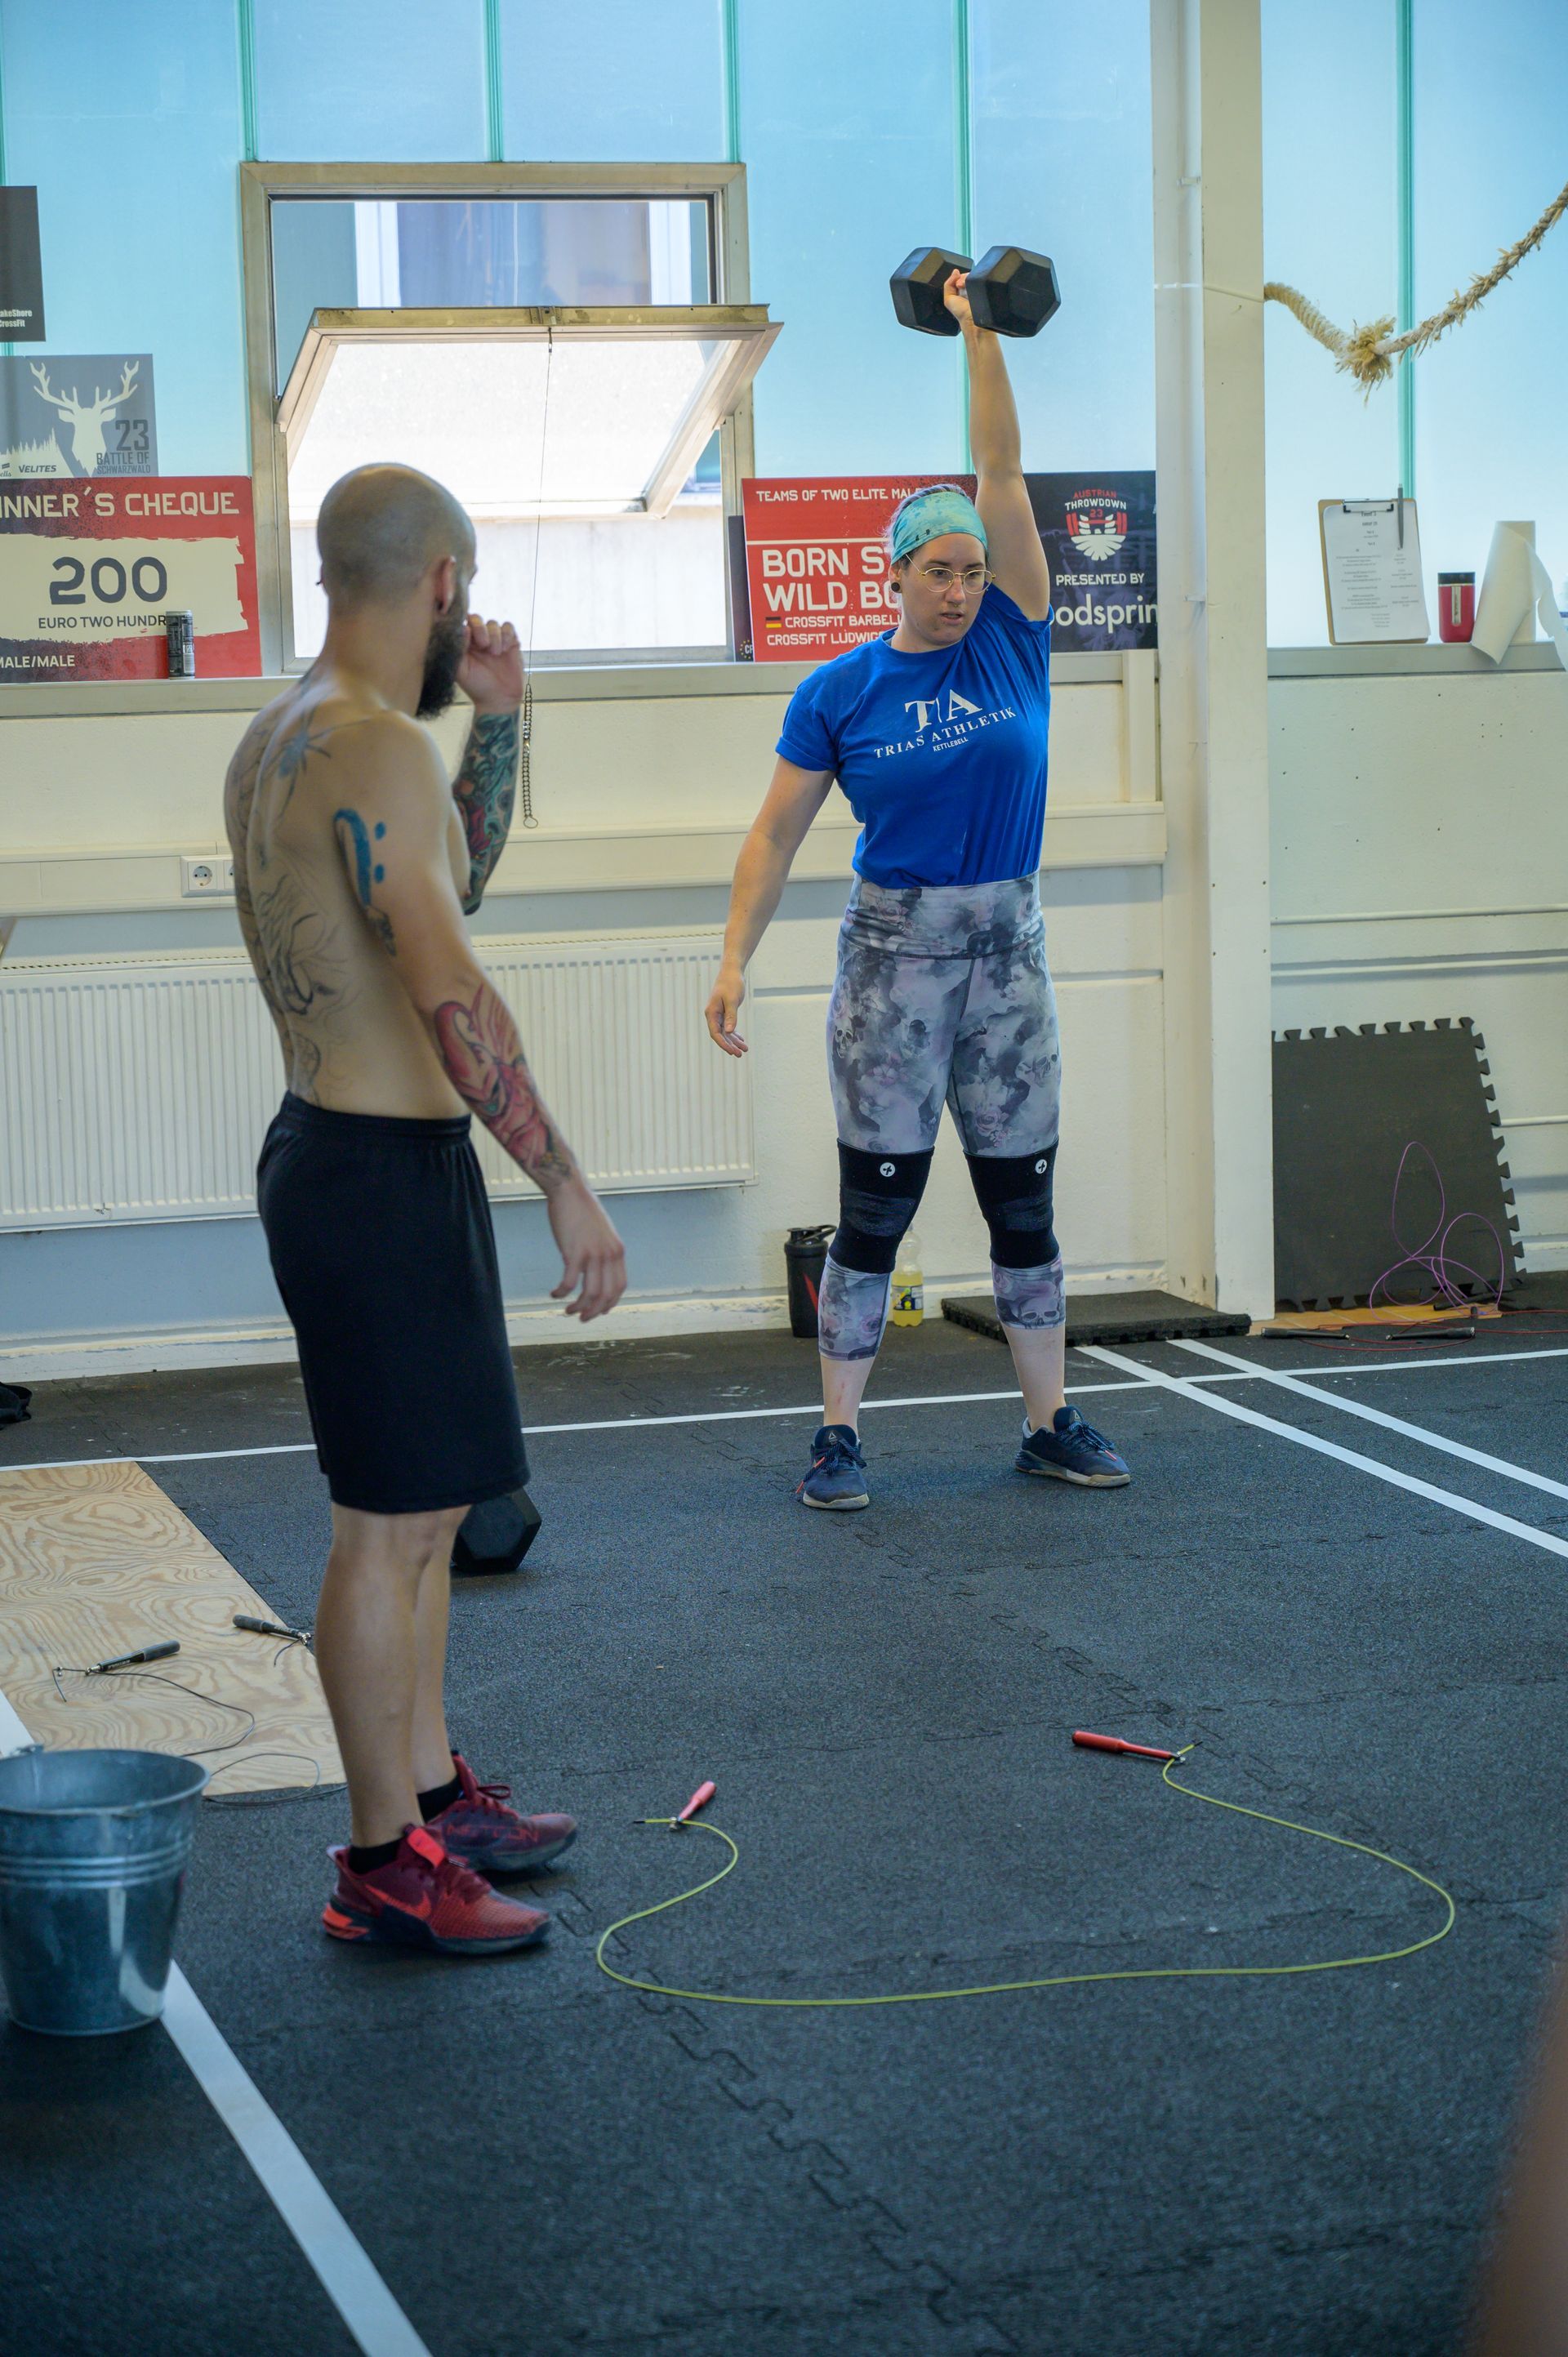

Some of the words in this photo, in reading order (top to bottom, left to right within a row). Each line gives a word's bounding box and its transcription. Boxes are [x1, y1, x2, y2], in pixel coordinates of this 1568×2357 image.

[115, 419, 150, 452] 23
[96, 452, 133, 466] BATTLE
[136, 451, 150, 465] OF
[18, 465, 57, 474] VELITES
[96, 464, 151, 475] SCHWARZWALD
[756, 490, 799, 502] TEAMS
[801, 490, 818, 501] OF
[821, 489, 849, 501] TWO
[852, 488, 889, 500] ELITE
[891, 488, 921, 499] MAL
[1072, 489, 1117, 499] AUSTRIAN
[125, 492, 240, 517] CHEQUE
[1064, 497, 1127, 511] THROWDOWN
[1089, 509, 1104, 518] 23
[762, 547, 849, 577] BORN
[860, 546, 890, 575] S
[49, 556, 168, 604] 200
[1055, 573, 1127, 586] PRESENTED
[1129, 573, 1145, 585] BY
[763, 581, 848, 612] WILD
[1051, 593, 1158, 634] odsprin
[38, 617, 78, 629] EURO
[80, 616, 114, 628] TWO
[785, 616, 845, 629] CROSSFIT
[766, 633, 830, 646] CROSSFIT
[831, 631, 883, 644] LUDWIG
[874, 735, 924, 759] TRIAS
[932, 706, 1017, 742] ATHLETIK
[932, 737, 969, 752] KETTLEBELL
